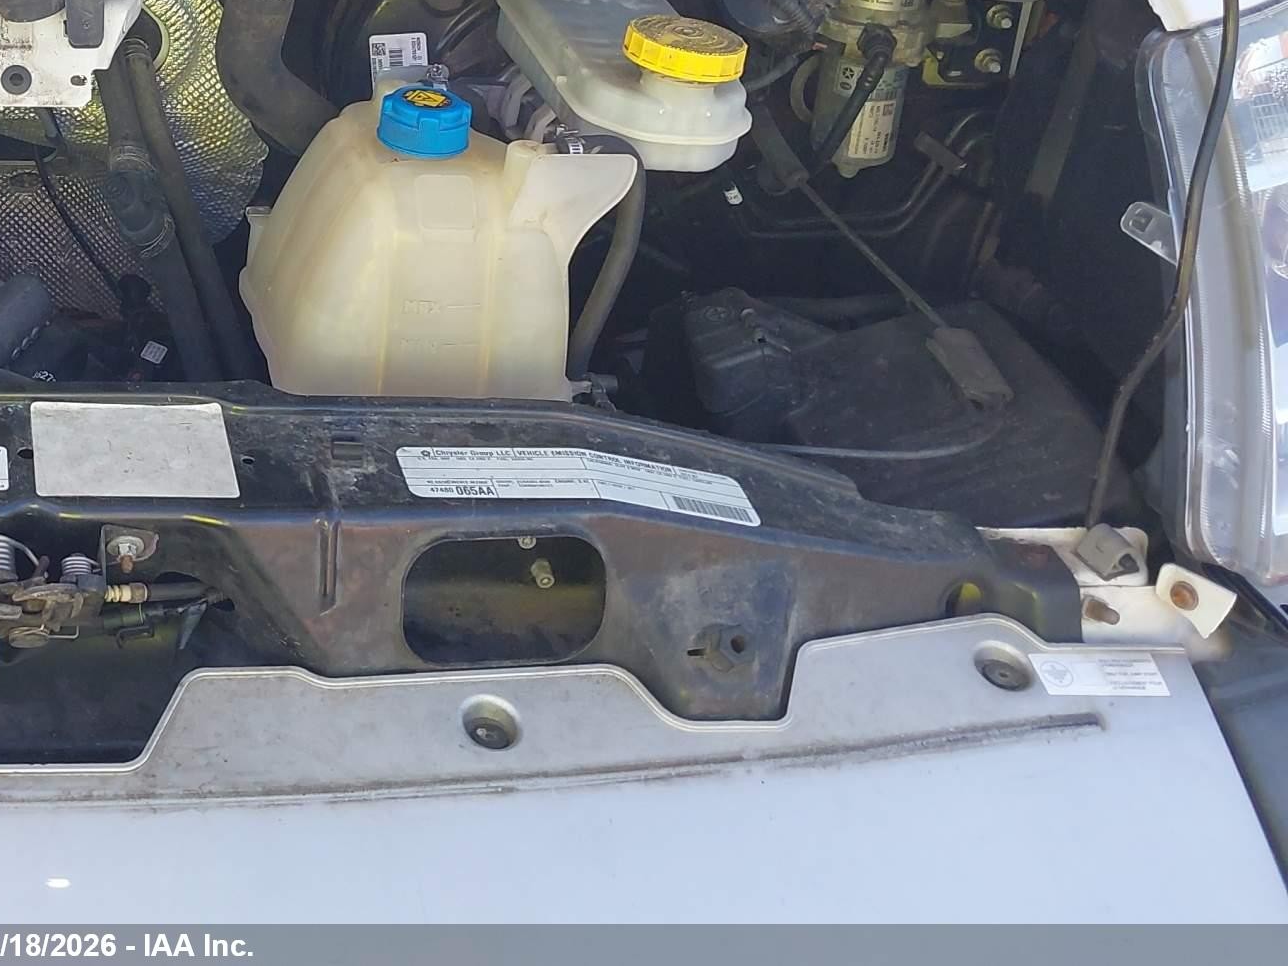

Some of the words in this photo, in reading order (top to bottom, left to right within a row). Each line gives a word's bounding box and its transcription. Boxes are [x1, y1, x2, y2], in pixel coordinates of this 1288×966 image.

[588, 452, 621, 464] CONTROL
[623, 459, 672, 473] INFORMATION
[455, 486, 495, 496] 065AA
